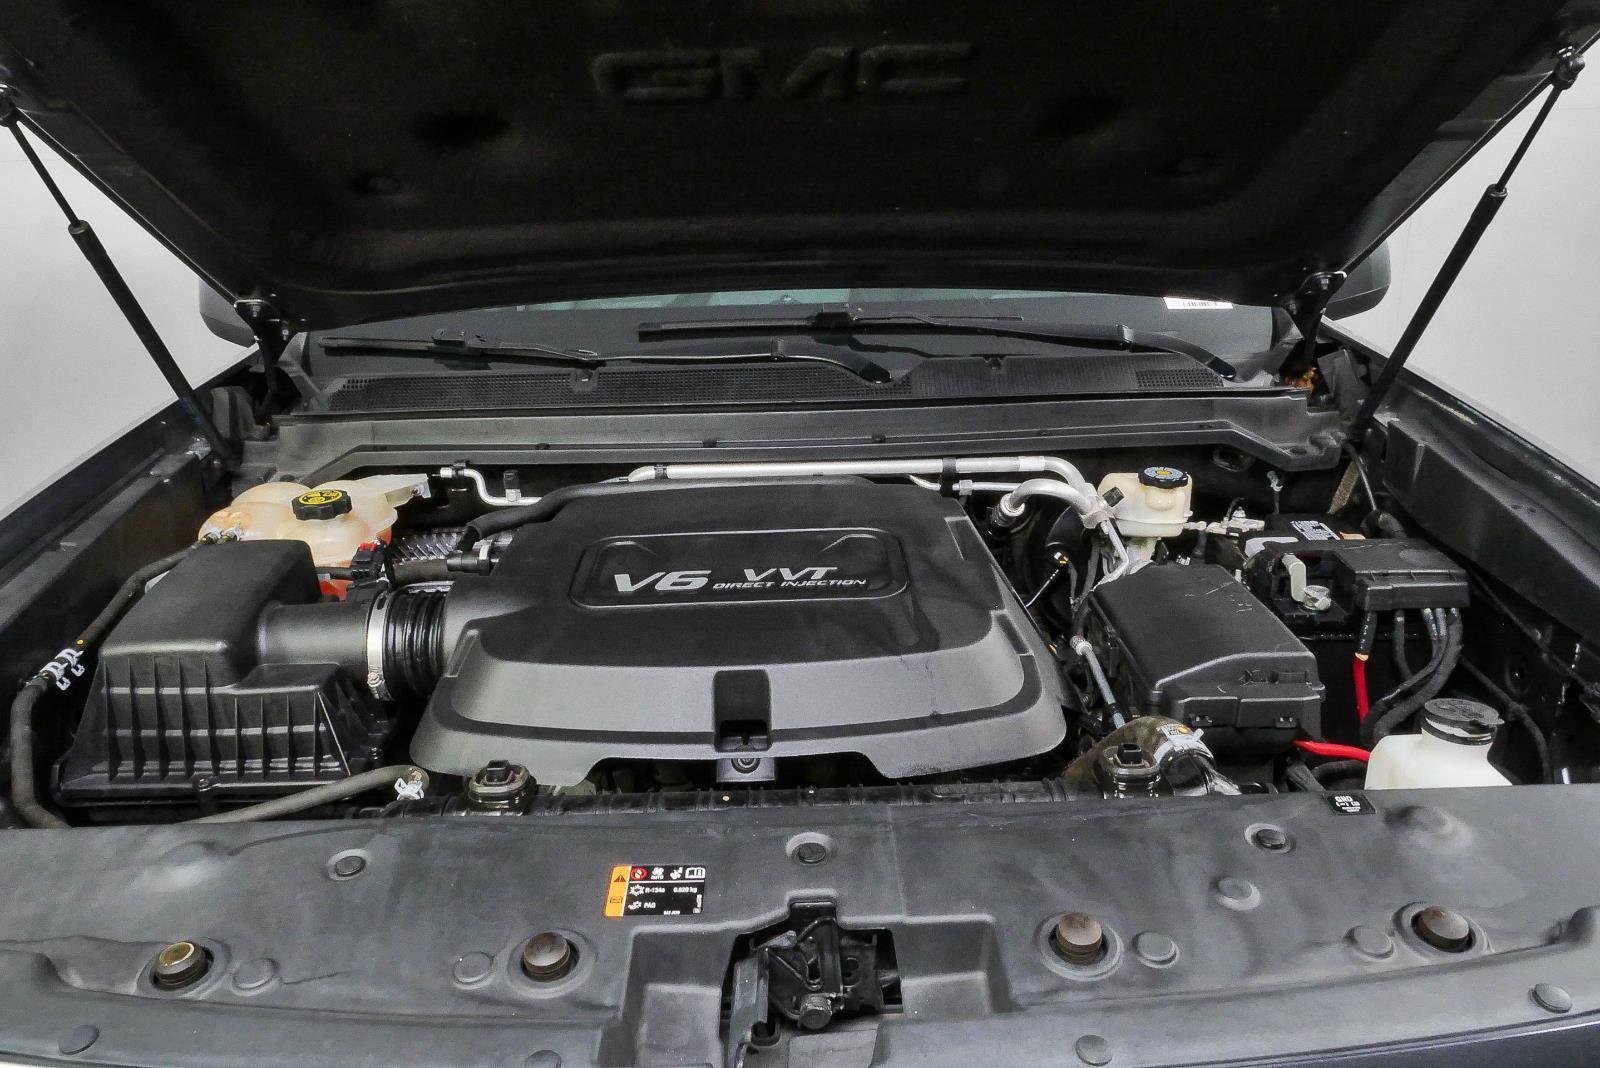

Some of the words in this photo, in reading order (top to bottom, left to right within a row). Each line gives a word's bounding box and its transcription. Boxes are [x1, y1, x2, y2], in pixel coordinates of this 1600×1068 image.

[591, 43, 978, 103] GMC
[614, 569, 712, 592] V6
[743, 566, 838, 581] VVT
[712, 581, 775, 590] DIRECT
[780, 579, 867, 588] INJECTION
